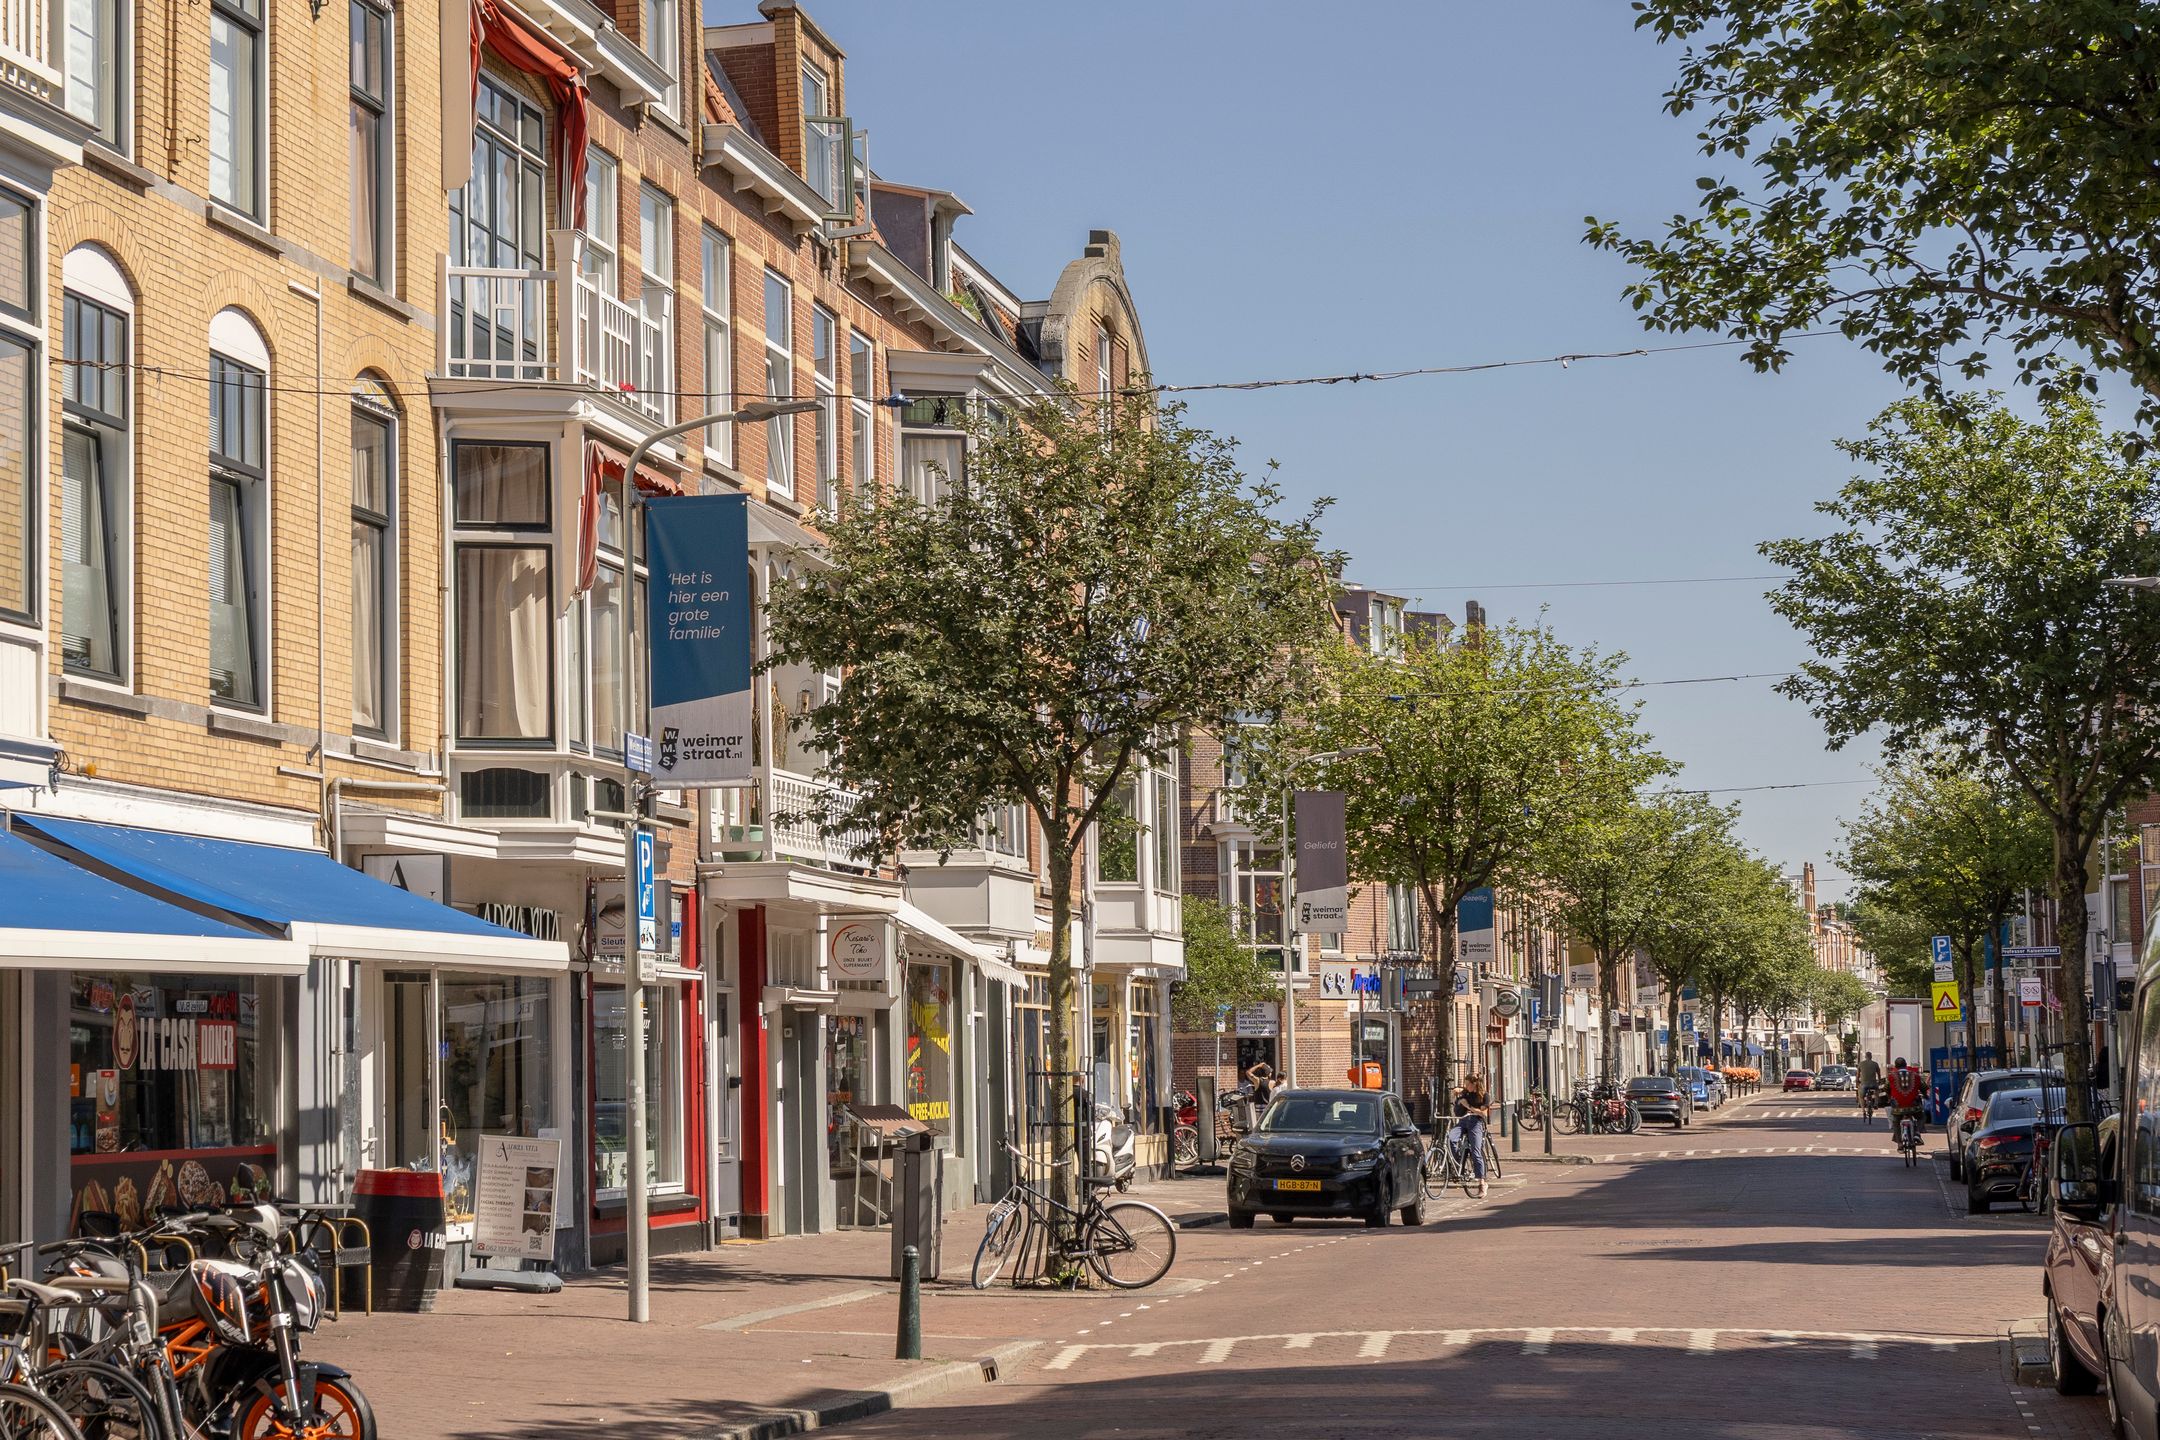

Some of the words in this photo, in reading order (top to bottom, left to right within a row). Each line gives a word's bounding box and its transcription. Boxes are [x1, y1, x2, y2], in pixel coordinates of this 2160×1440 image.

[701, 571, 712, 584] is
[668, 591, 697, 603] hier
[701, 591, 729, 602] een
[668, 609, 709, 626] grote
[682, 733, 743, 747] weimar
[682, 748, 742, 760] straat.nl
[1304, 841, 1337, 850] Geliefd
[641, 841, 651, 883] P
[1936, 939, 1947, 953] P
[1683, 1014, 1691, 1024] P
[140, 1017, 156, 1070] LA
[160, 1018, 198, 1070] CASA
[200, 1025, 234, 1065] DONER
[1280, 1181, 1319, 1190] HGB-87-N
[424, 1232, 433, 1248] LA
